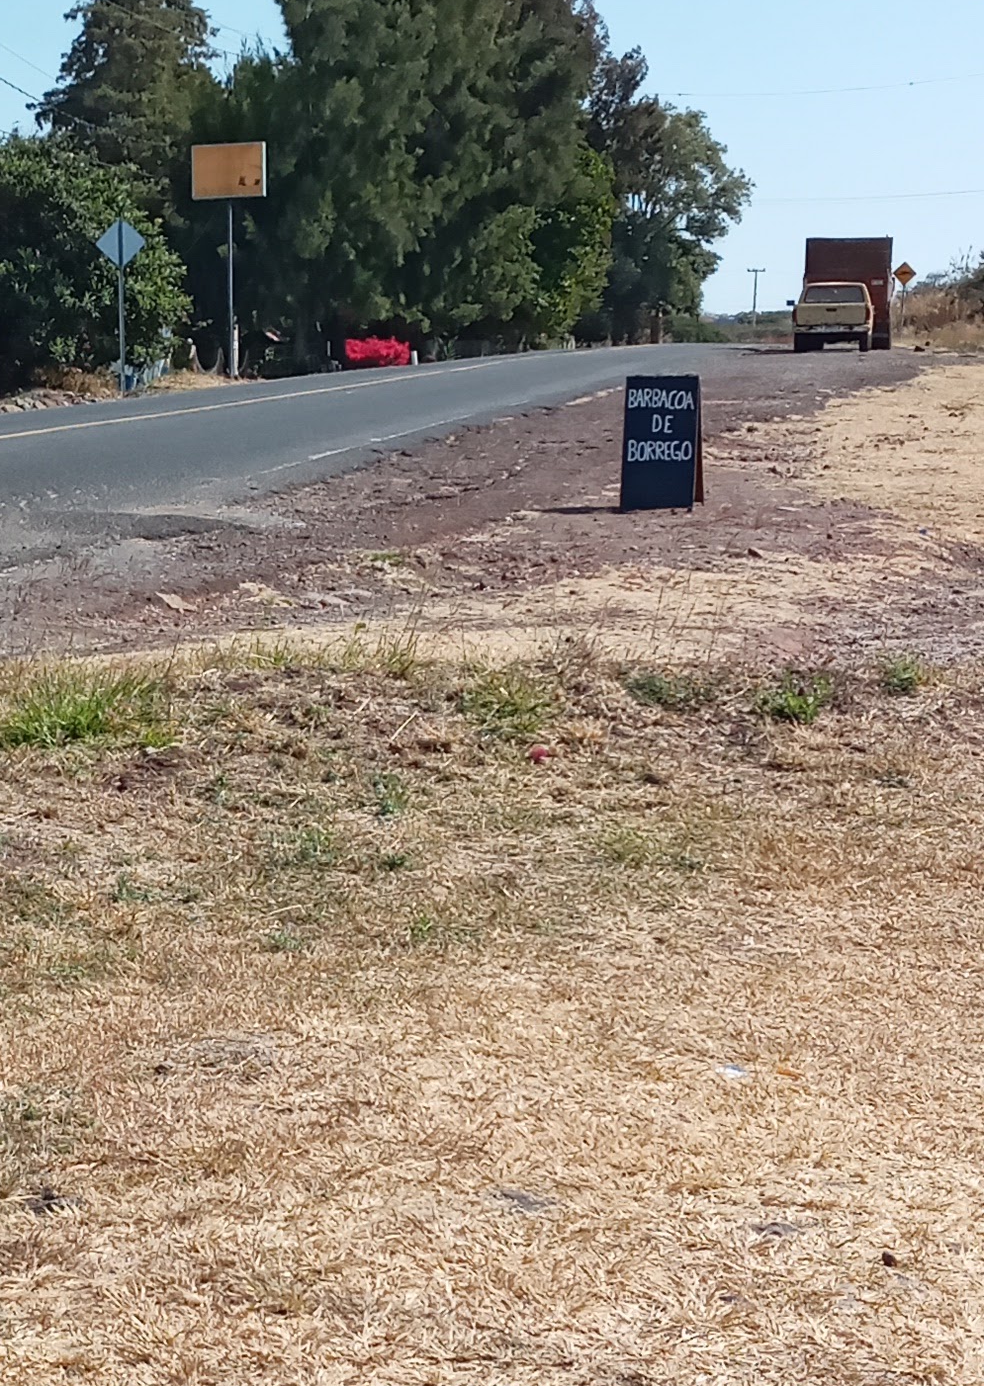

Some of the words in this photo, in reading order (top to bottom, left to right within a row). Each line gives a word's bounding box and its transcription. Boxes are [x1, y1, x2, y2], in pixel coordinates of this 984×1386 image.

[628, 388, 695, 410] BARBACOA
[651, 414, 674, 433] DE
[627, 439, 693, 462] BORREGO
